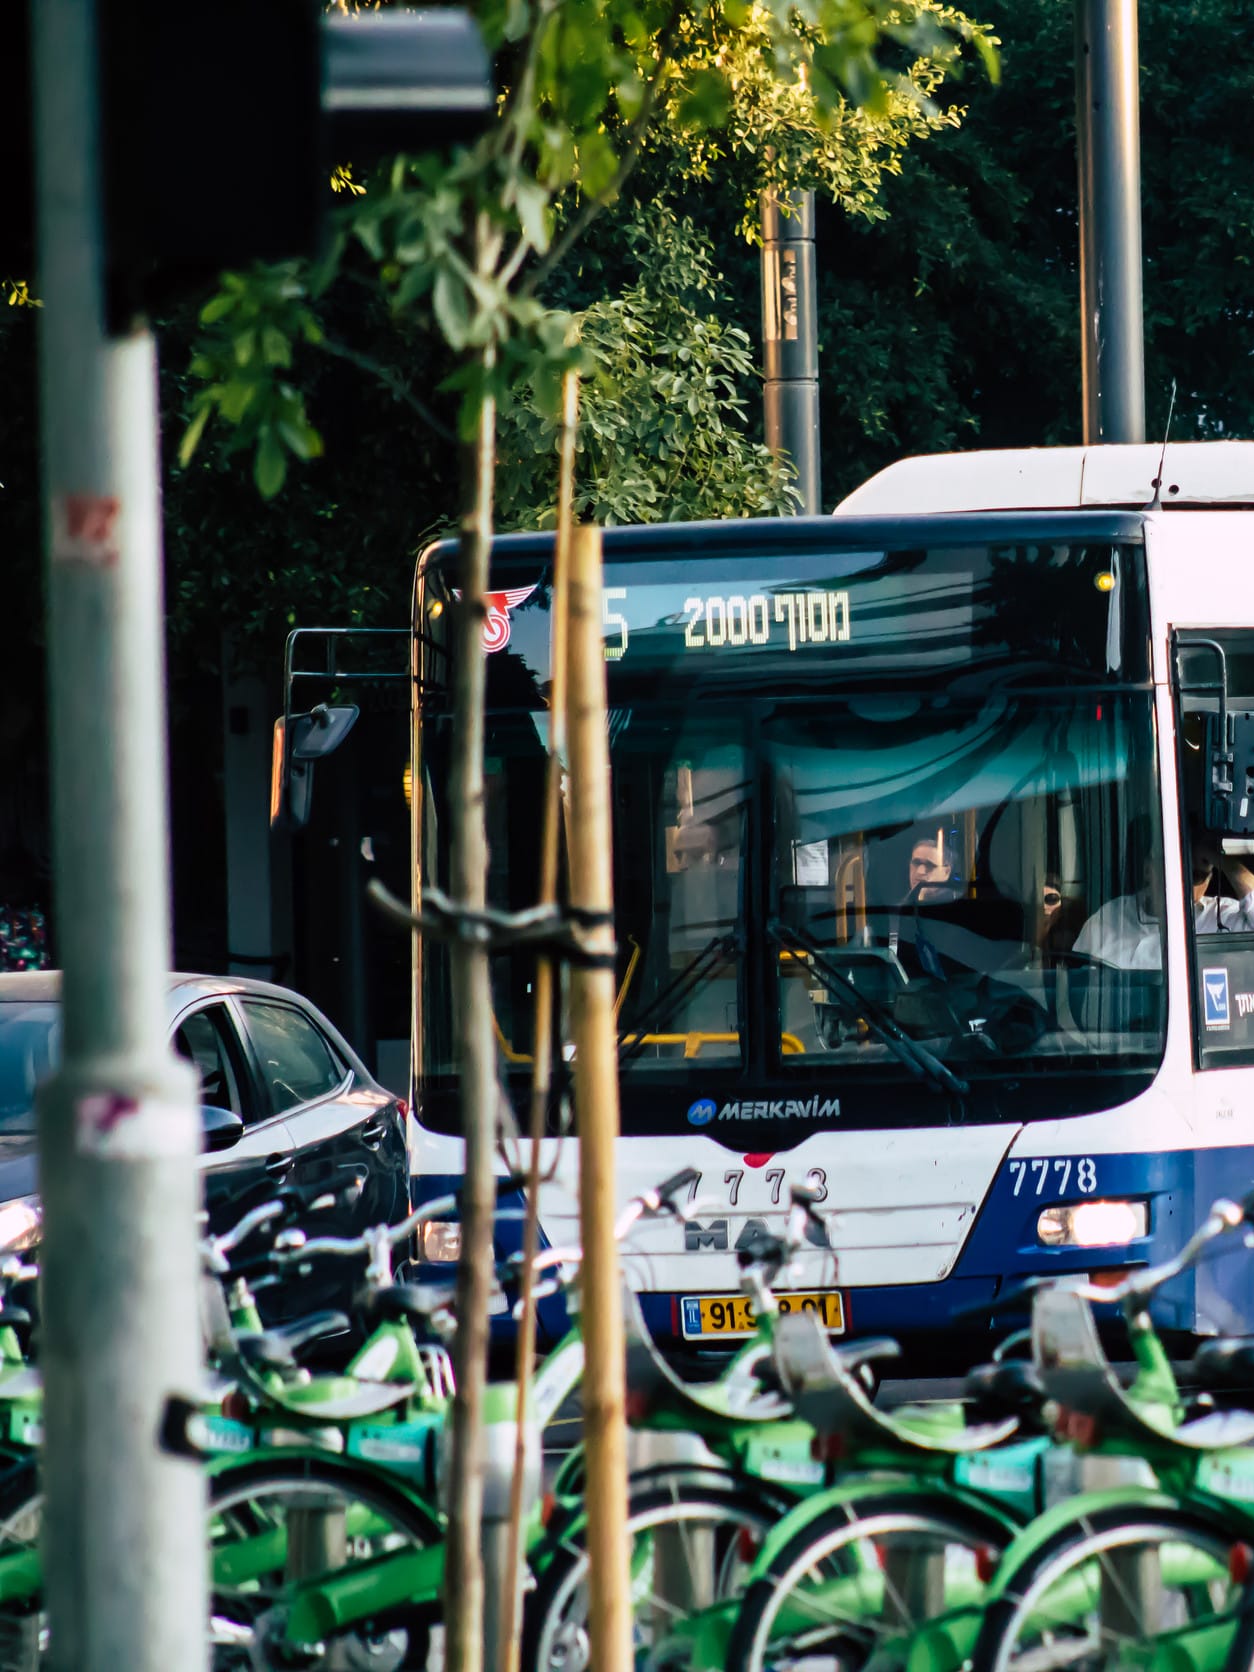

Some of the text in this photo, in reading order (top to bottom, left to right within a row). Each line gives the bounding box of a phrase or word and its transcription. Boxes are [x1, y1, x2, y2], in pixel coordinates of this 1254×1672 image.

[684, 591, 850, 651] מסוף 2000
[1009, 1158, 1097, 1197] 7778
